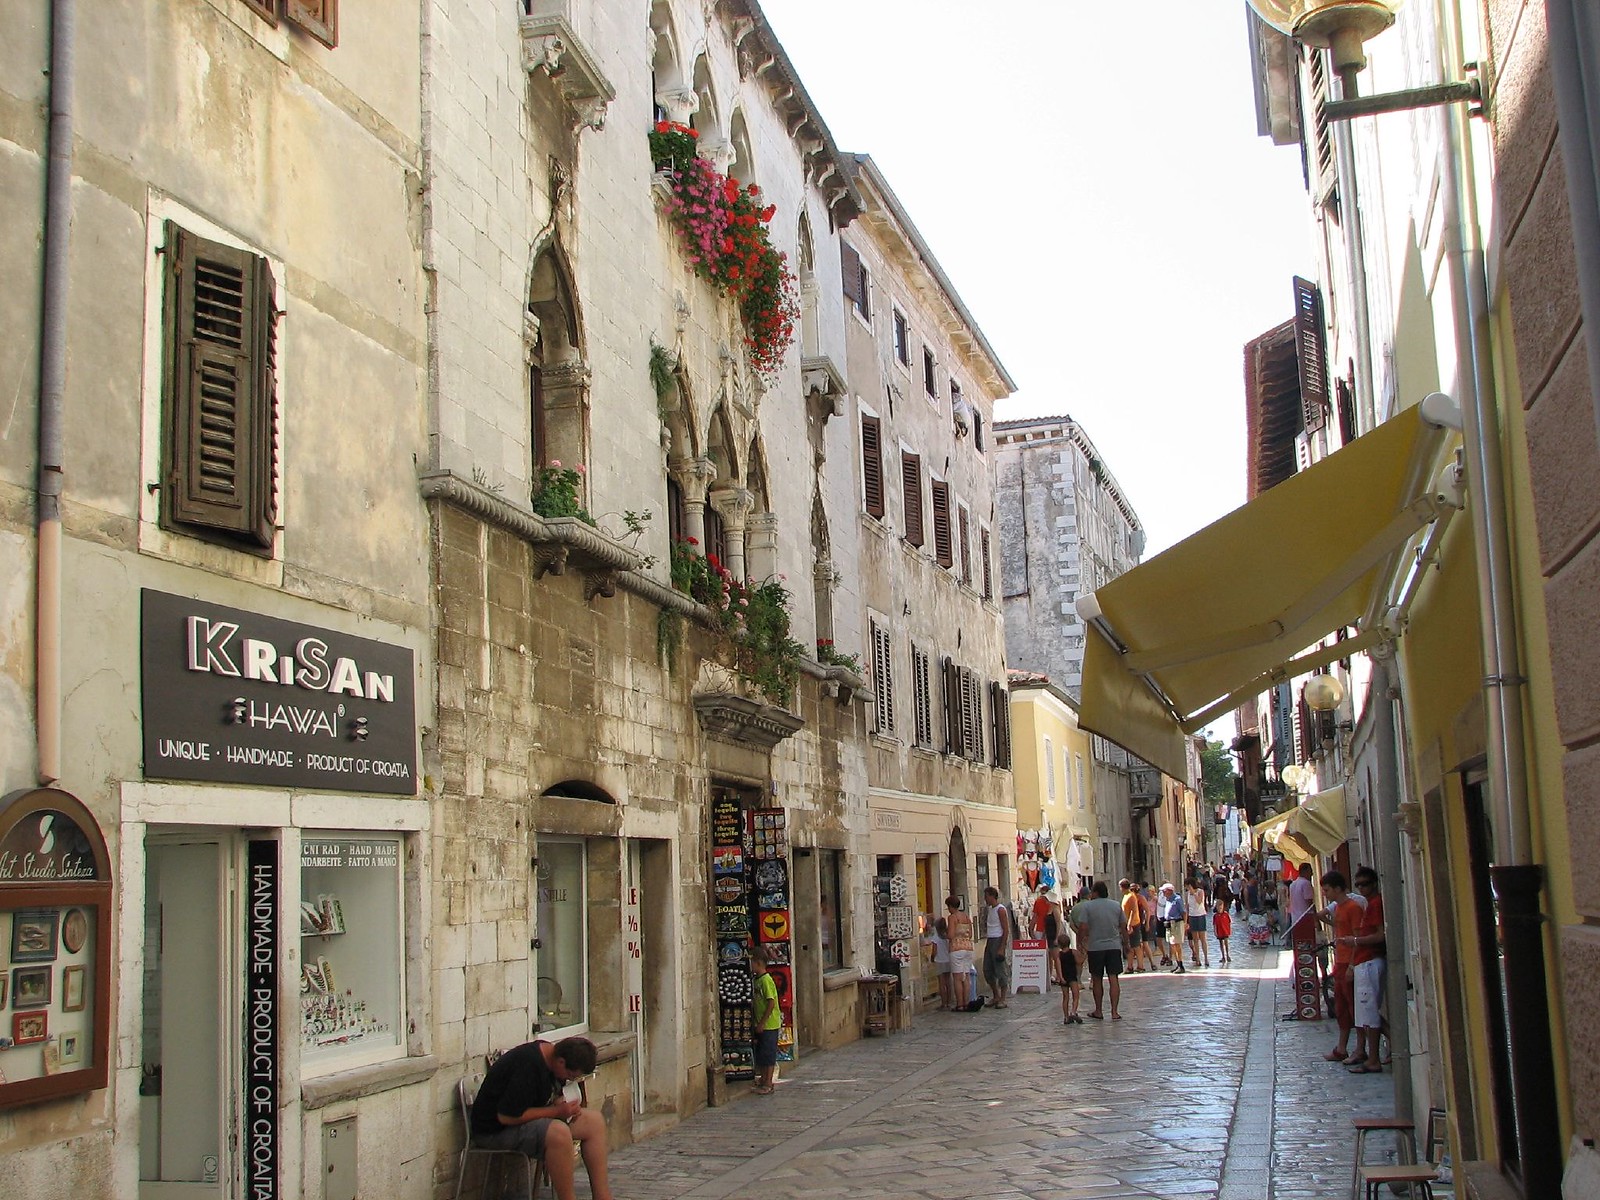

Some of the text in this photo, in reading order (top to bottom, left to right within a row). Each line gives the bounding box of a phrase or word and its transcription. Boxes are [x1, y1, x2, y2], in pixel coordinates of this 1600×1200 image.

[159, 738, 410, 778] UNIQUE HANDMADE PRODUCT OF CROATIA
[19, 851, 57, 878] Studio
[322, 845, 340, 855] RAD
[349, 845, 372, 856] HAND
[375, 845, 397, 856] MADE
[348, 857, 370, 867] FATTO
[371, 857, 377, 867] A
[377, 857, 397, 867] MANO
[253, 865, 273, 974] HANDMADE
[253, 988, 273, 1081] PRODUCT
[253, 1085, 273, 1114] OF
